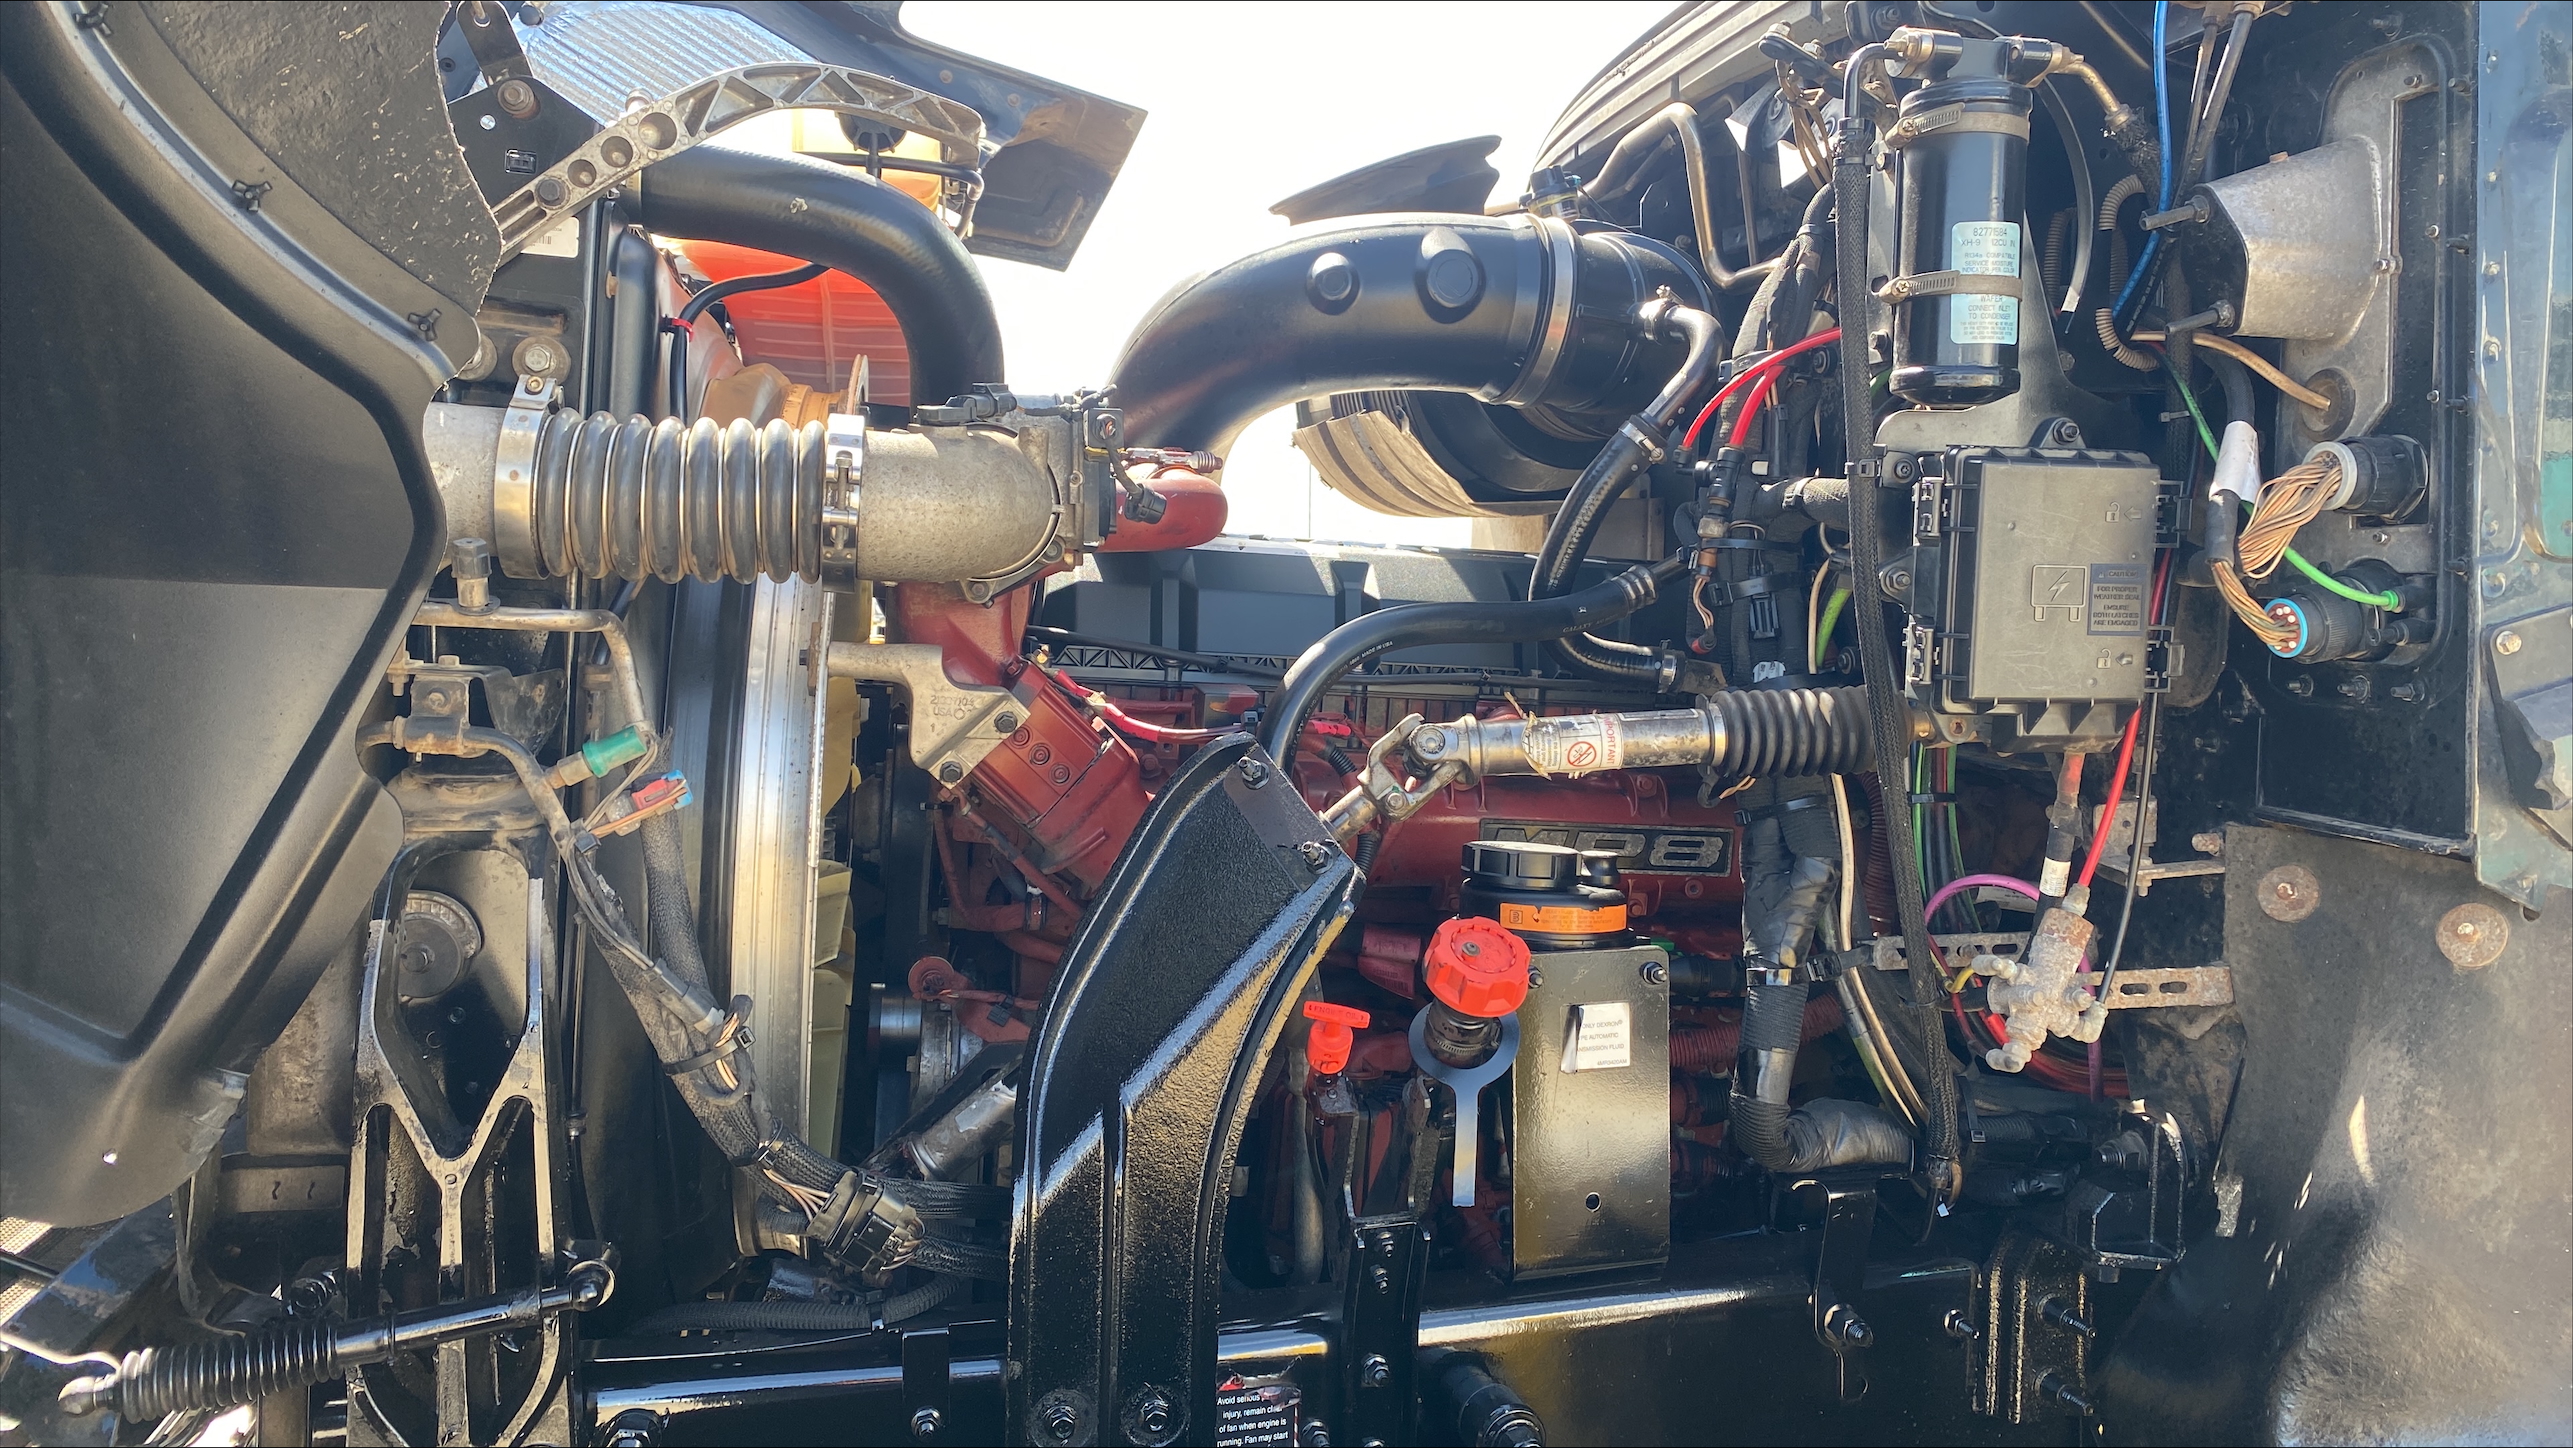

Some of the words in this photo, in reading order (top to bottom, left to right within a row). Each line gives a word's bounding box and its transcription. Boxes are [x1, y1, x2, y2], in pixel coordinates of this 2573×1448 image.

[1217, 1395, 1236, 1406] Avoid
[1243, 1406, 1266, 1416] remain
[1218, 1425, 1226, 1433] of
[1226, 1423, 1238, 1432] fan
[1239, 1420, 1257, 1431] when
[1257, 1419, 1280, 1430] engine
[1280, 1417, 1287, 1425] is
[1245, 1435, 1258, 1444] Fan
[1258, 1432, 1273, 1443] may
[1273, 1430, 1289, 1440] start
